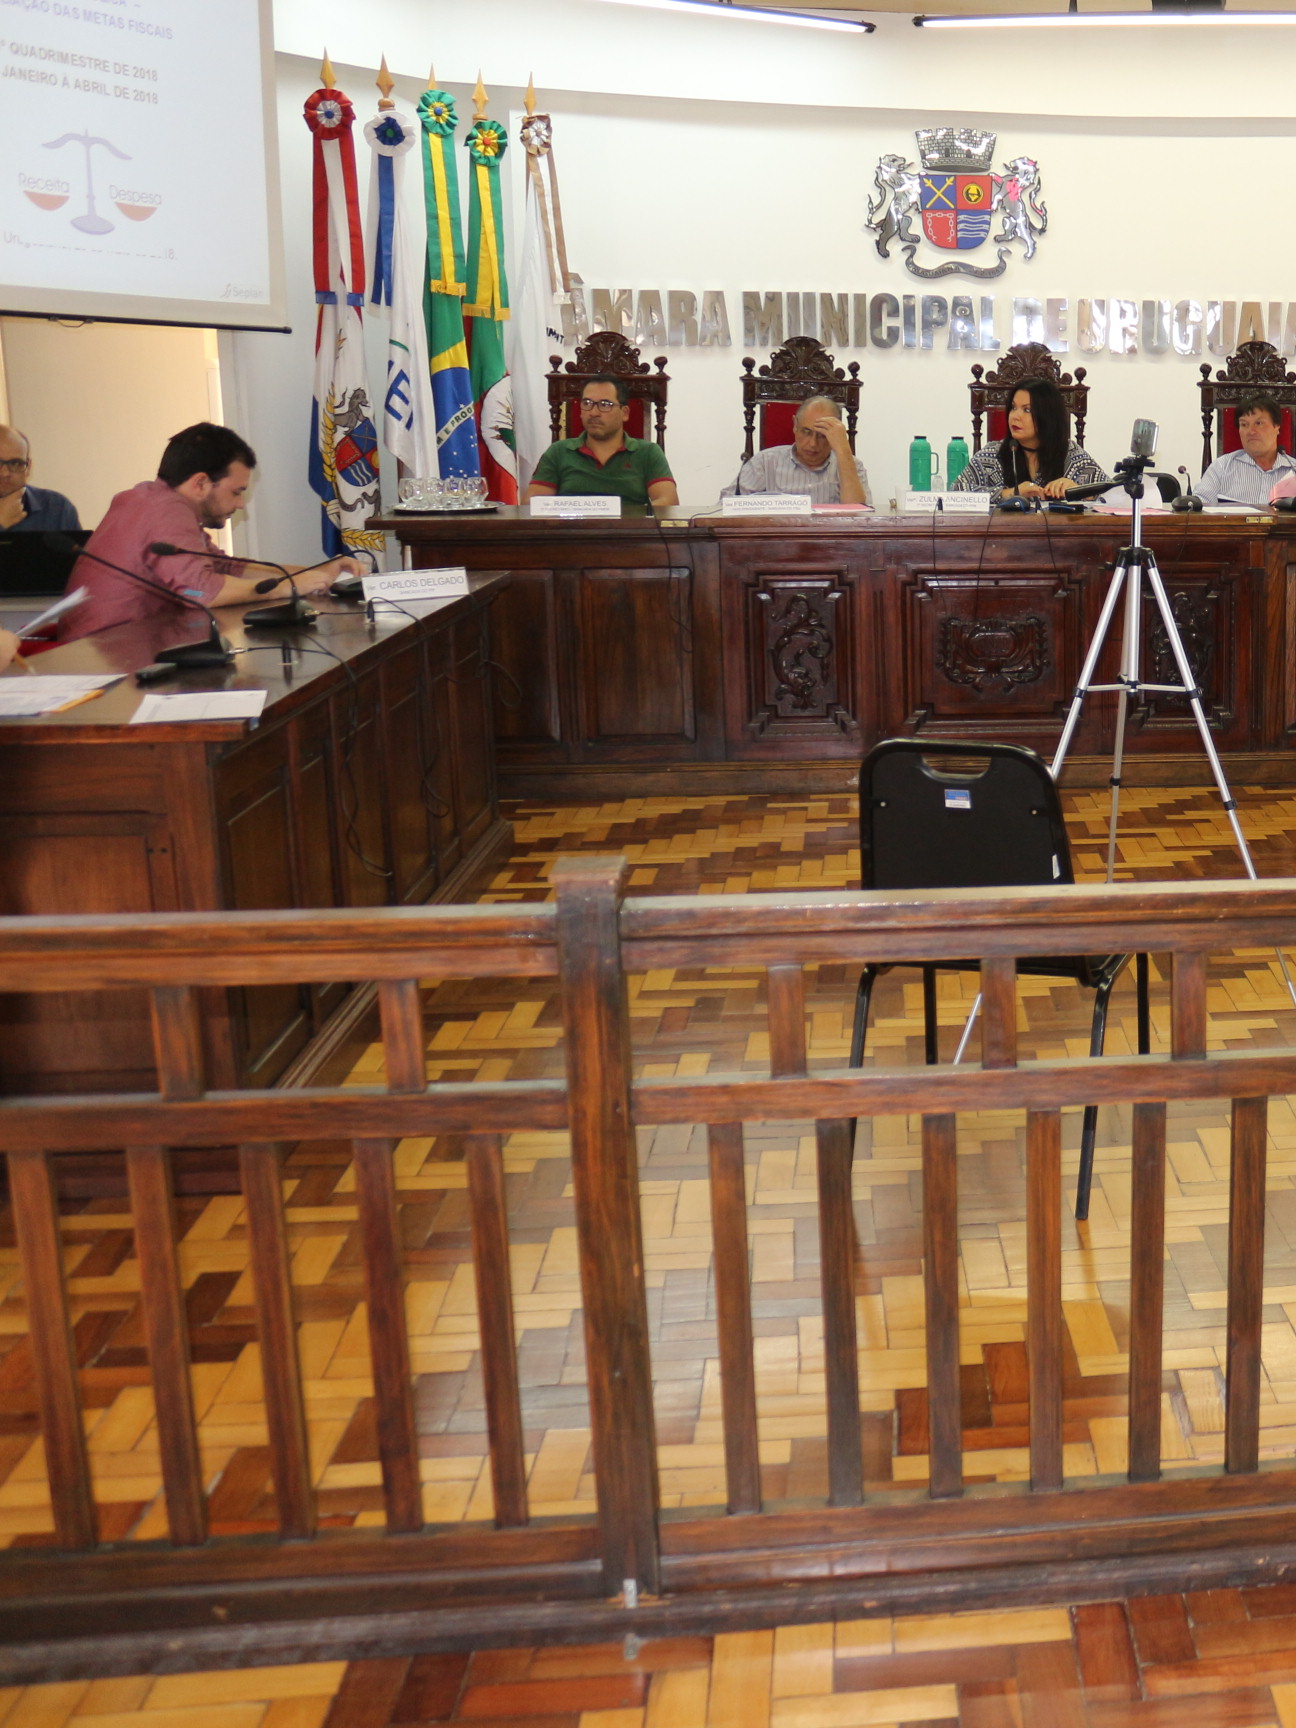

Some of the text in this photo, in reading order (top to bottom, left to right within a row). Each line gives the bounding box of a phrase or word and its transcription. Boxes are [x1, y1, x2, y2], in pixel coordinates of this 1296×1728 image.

[53, 2, 81, 20] DAS
[83, 8, 125, 30] METAS
[127, 18, 175, 41] FISCAIS
[9, 41, 111, 74] QUADRIMESTRE
[112, 61, 131, 77] DE
[132, 65, 159, 83] 2018
[2, 63, 59, 88] JANEIRO
[73, 77, 112, 97] ABRIL
[113, 85, 131, 101] DE
[132, 87, 160, 106] 2018
[17, 171, 71, 194] Receita
[108, 183, 163, 206] Despesa
[741, 289, 1001, 351] MUNICIPAL
[1011, 296, 1070, 353] DE
[379, 579, 418, 590] CARLOS
[420, 575, 465, 587] DELGADO
